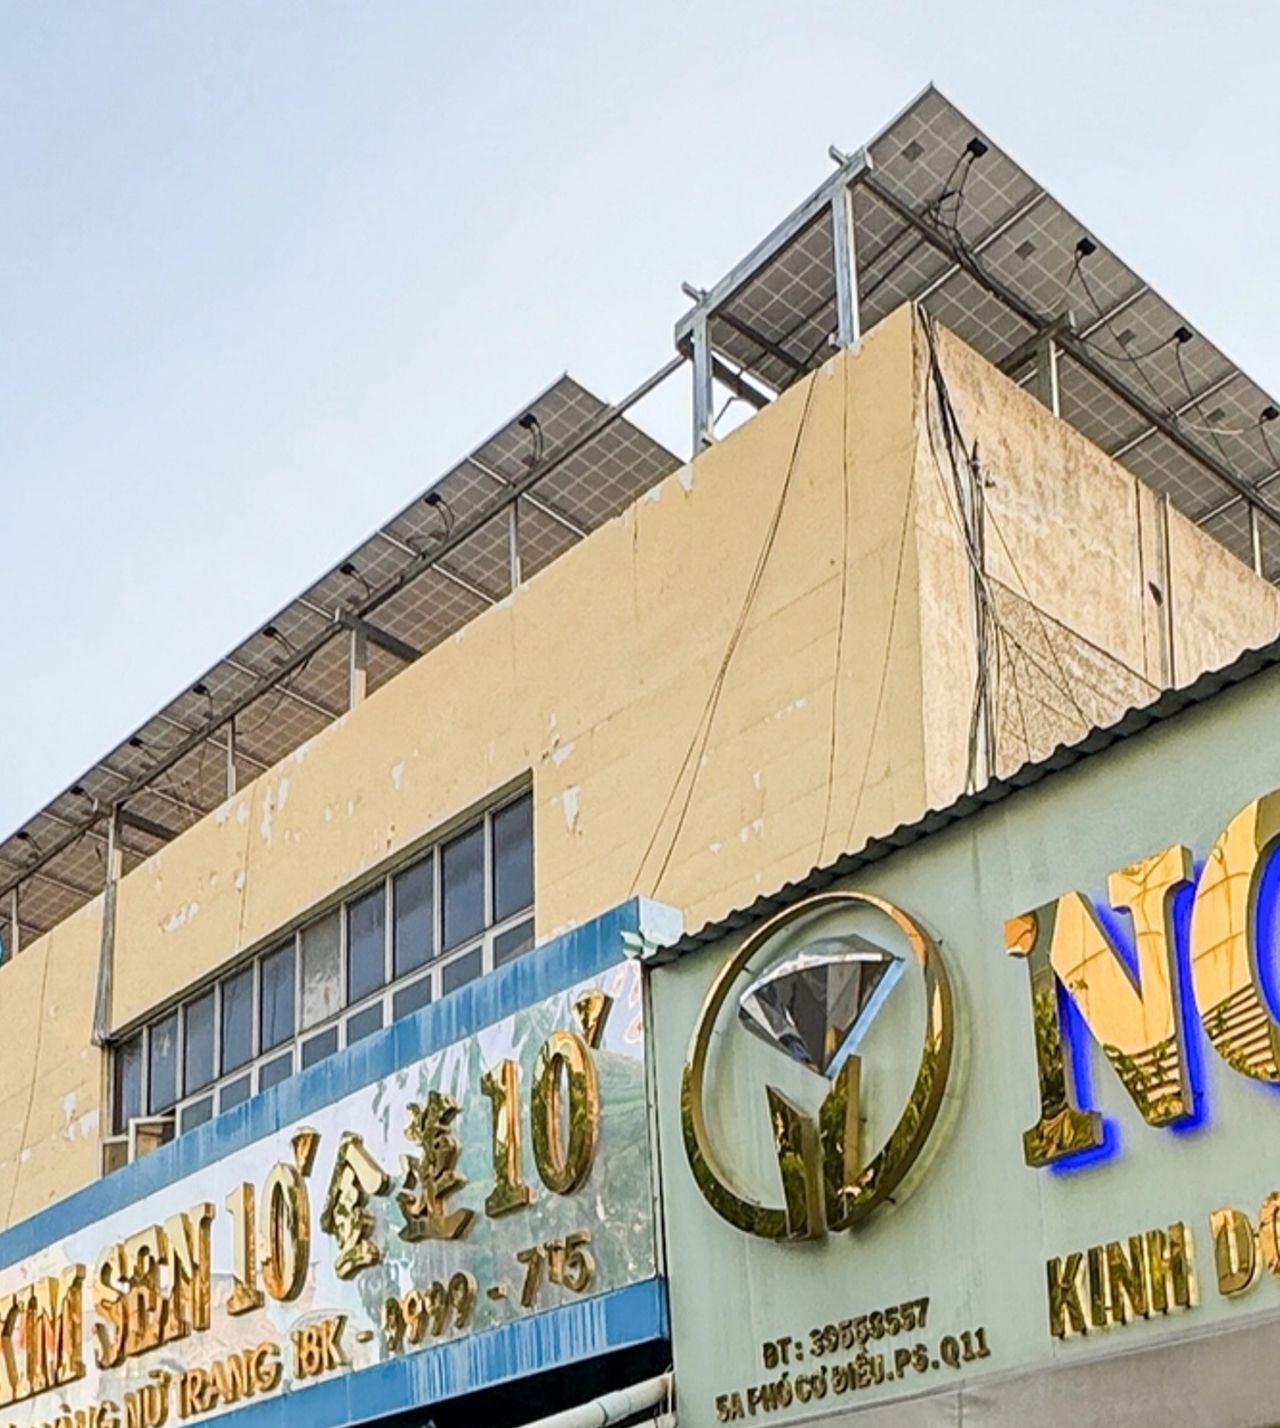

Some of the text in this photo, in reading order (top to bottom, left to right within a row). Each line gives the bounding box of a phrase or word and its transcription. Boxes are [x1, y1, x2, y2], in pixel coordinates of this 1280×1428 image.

[95, 1202, 216, 1370] SEN
[1046, 1220, 1197, 1340] KINH
[175, 1341, 283, 1419] TRANG
[289, 1313, 349, 1381] 18K
